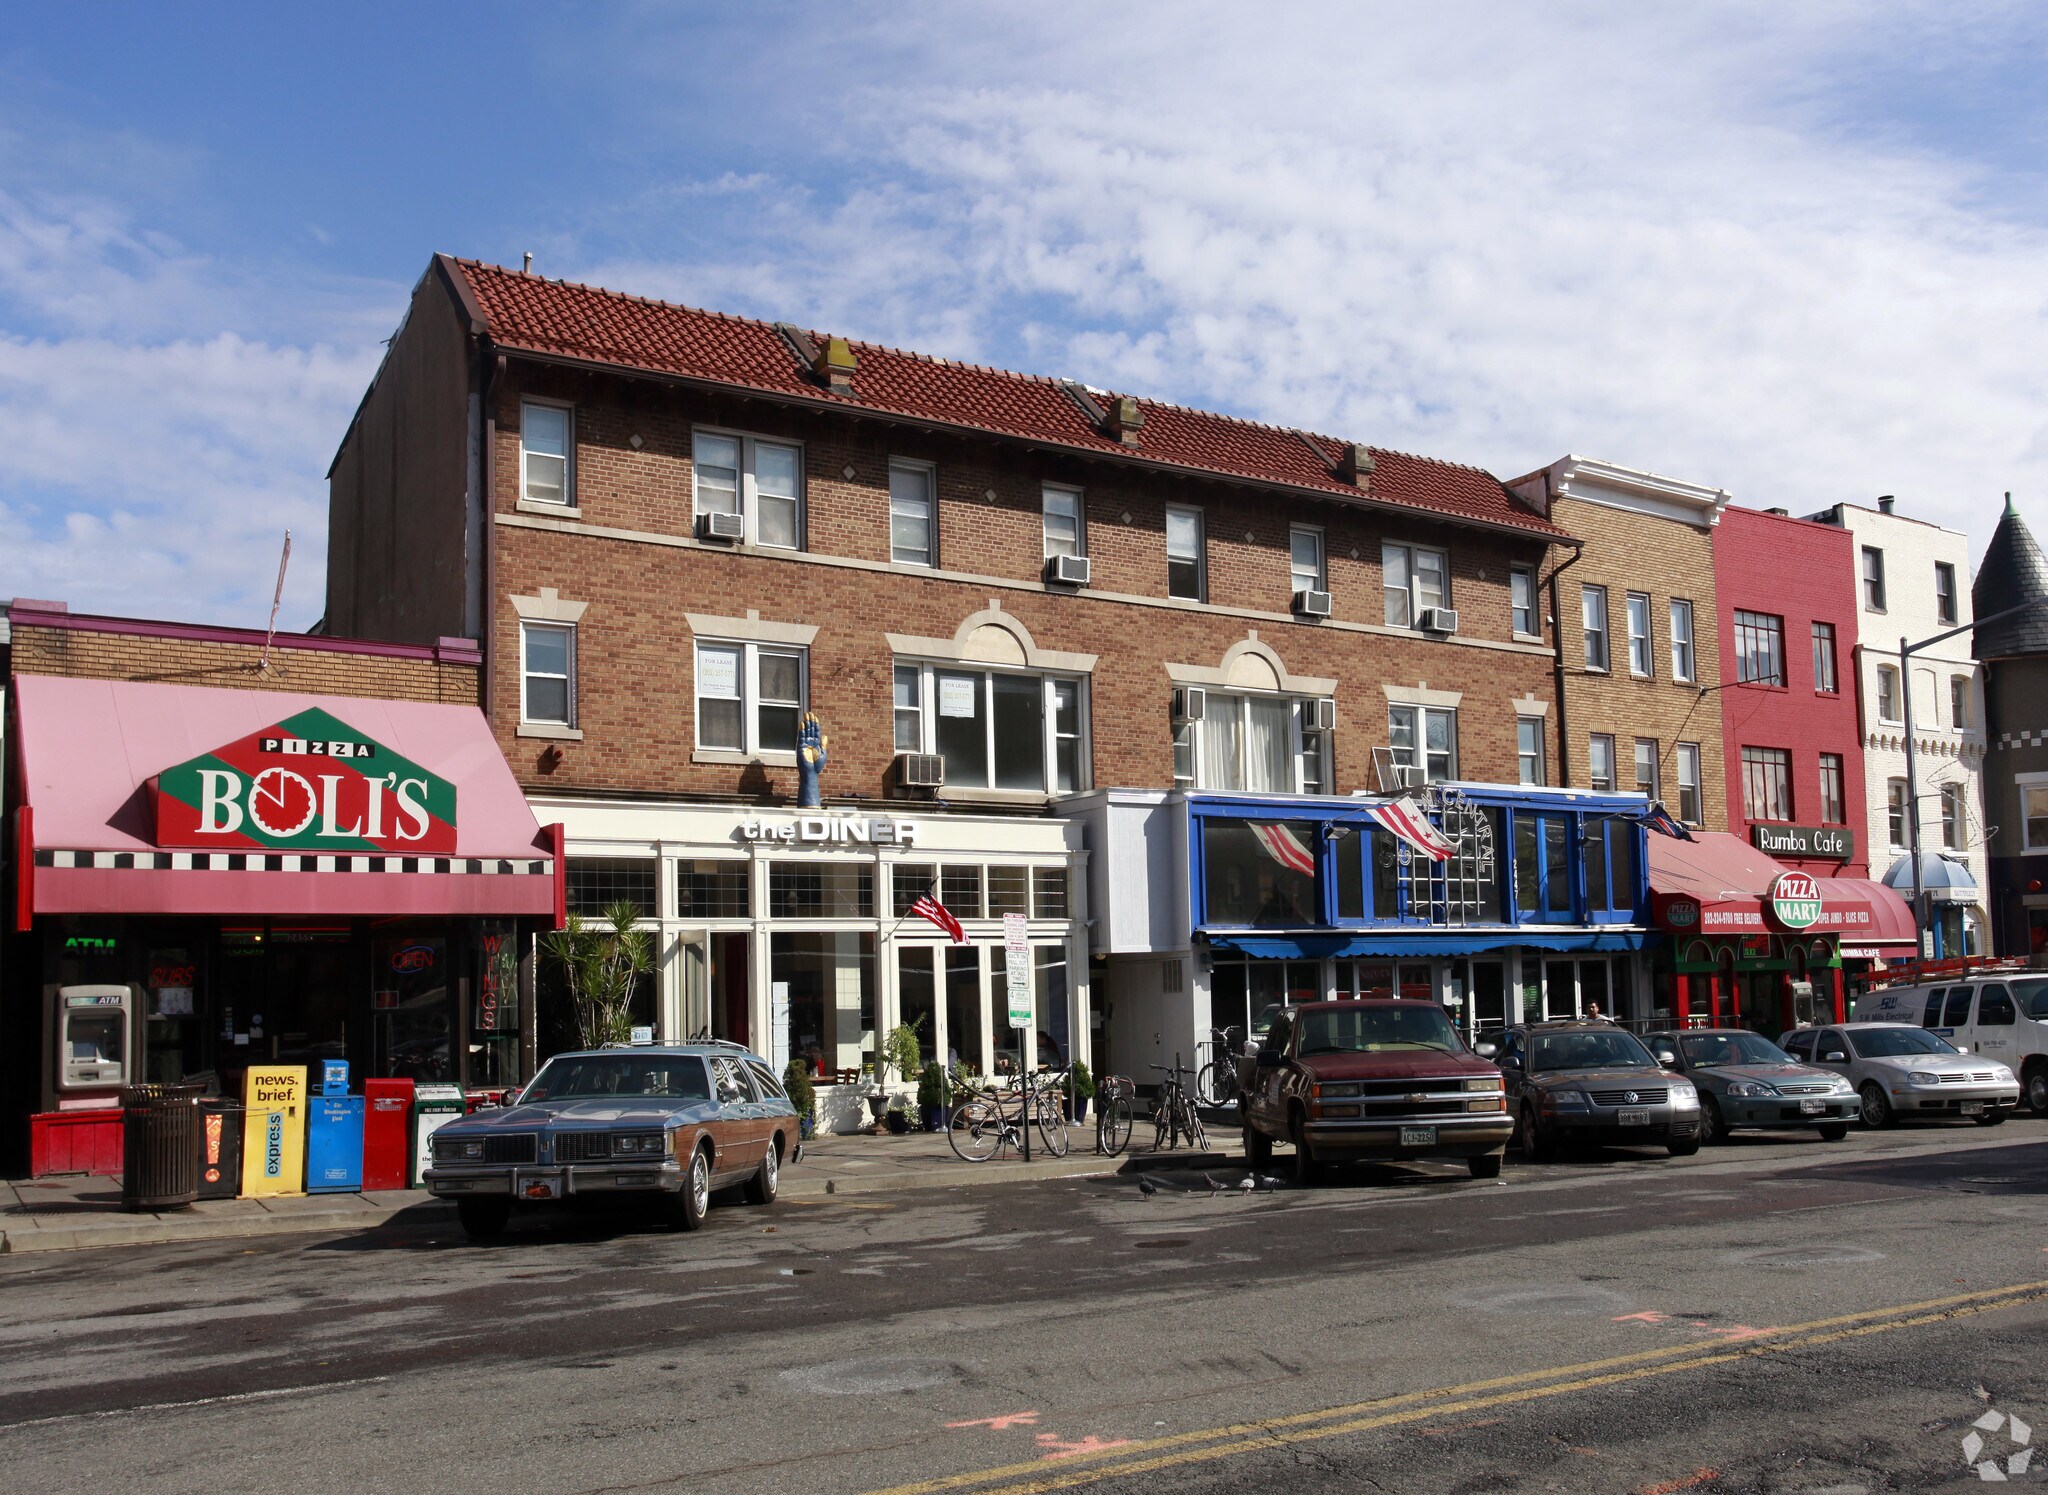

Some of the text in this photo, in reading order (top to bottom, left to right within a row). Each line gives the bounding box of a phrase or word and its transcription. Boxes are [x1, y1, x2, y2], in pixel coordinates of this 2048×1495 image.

[265, 738, 370, 757] PIZZA
[194, 766, 430, 841] BOLI'S
[742, 816, 919, 844] the DINER
[1442, 787, 1496, 874] CENTRAL
[1760, 827, 1843, 853] Rumba Cafe
[1780, 879, 1819, 898] PIZZA
[1671, 904, 1696, 913] PIZZA
[1780, 902, 1817, 920] MART
[1845, 911, 1857, 923] SLICE
[1857, 911, 1869, 923] PIZZA
[1671, 914, 1695, 922] MART
[1733, 912, 1743, 924] FREE
[65, 937, 118, 950] ATM
[1841, 948, 1881, 957] RUMBA CAFE
[391, 951, 434, 970] OPEN
[150, 963, 197, 988] SUBS
[481, 935, 502, 1030] WINGS
[99, 996, 120, 1005] ATM
[1872, 1012, 1884, 1021] Mills
[1885, 1011, 1914, 1021] Electrical
[255, 1075, 299, 1086] news.
[257, 1088, 295, 1102] brief.
[268, 1114, 281, 1175] express
